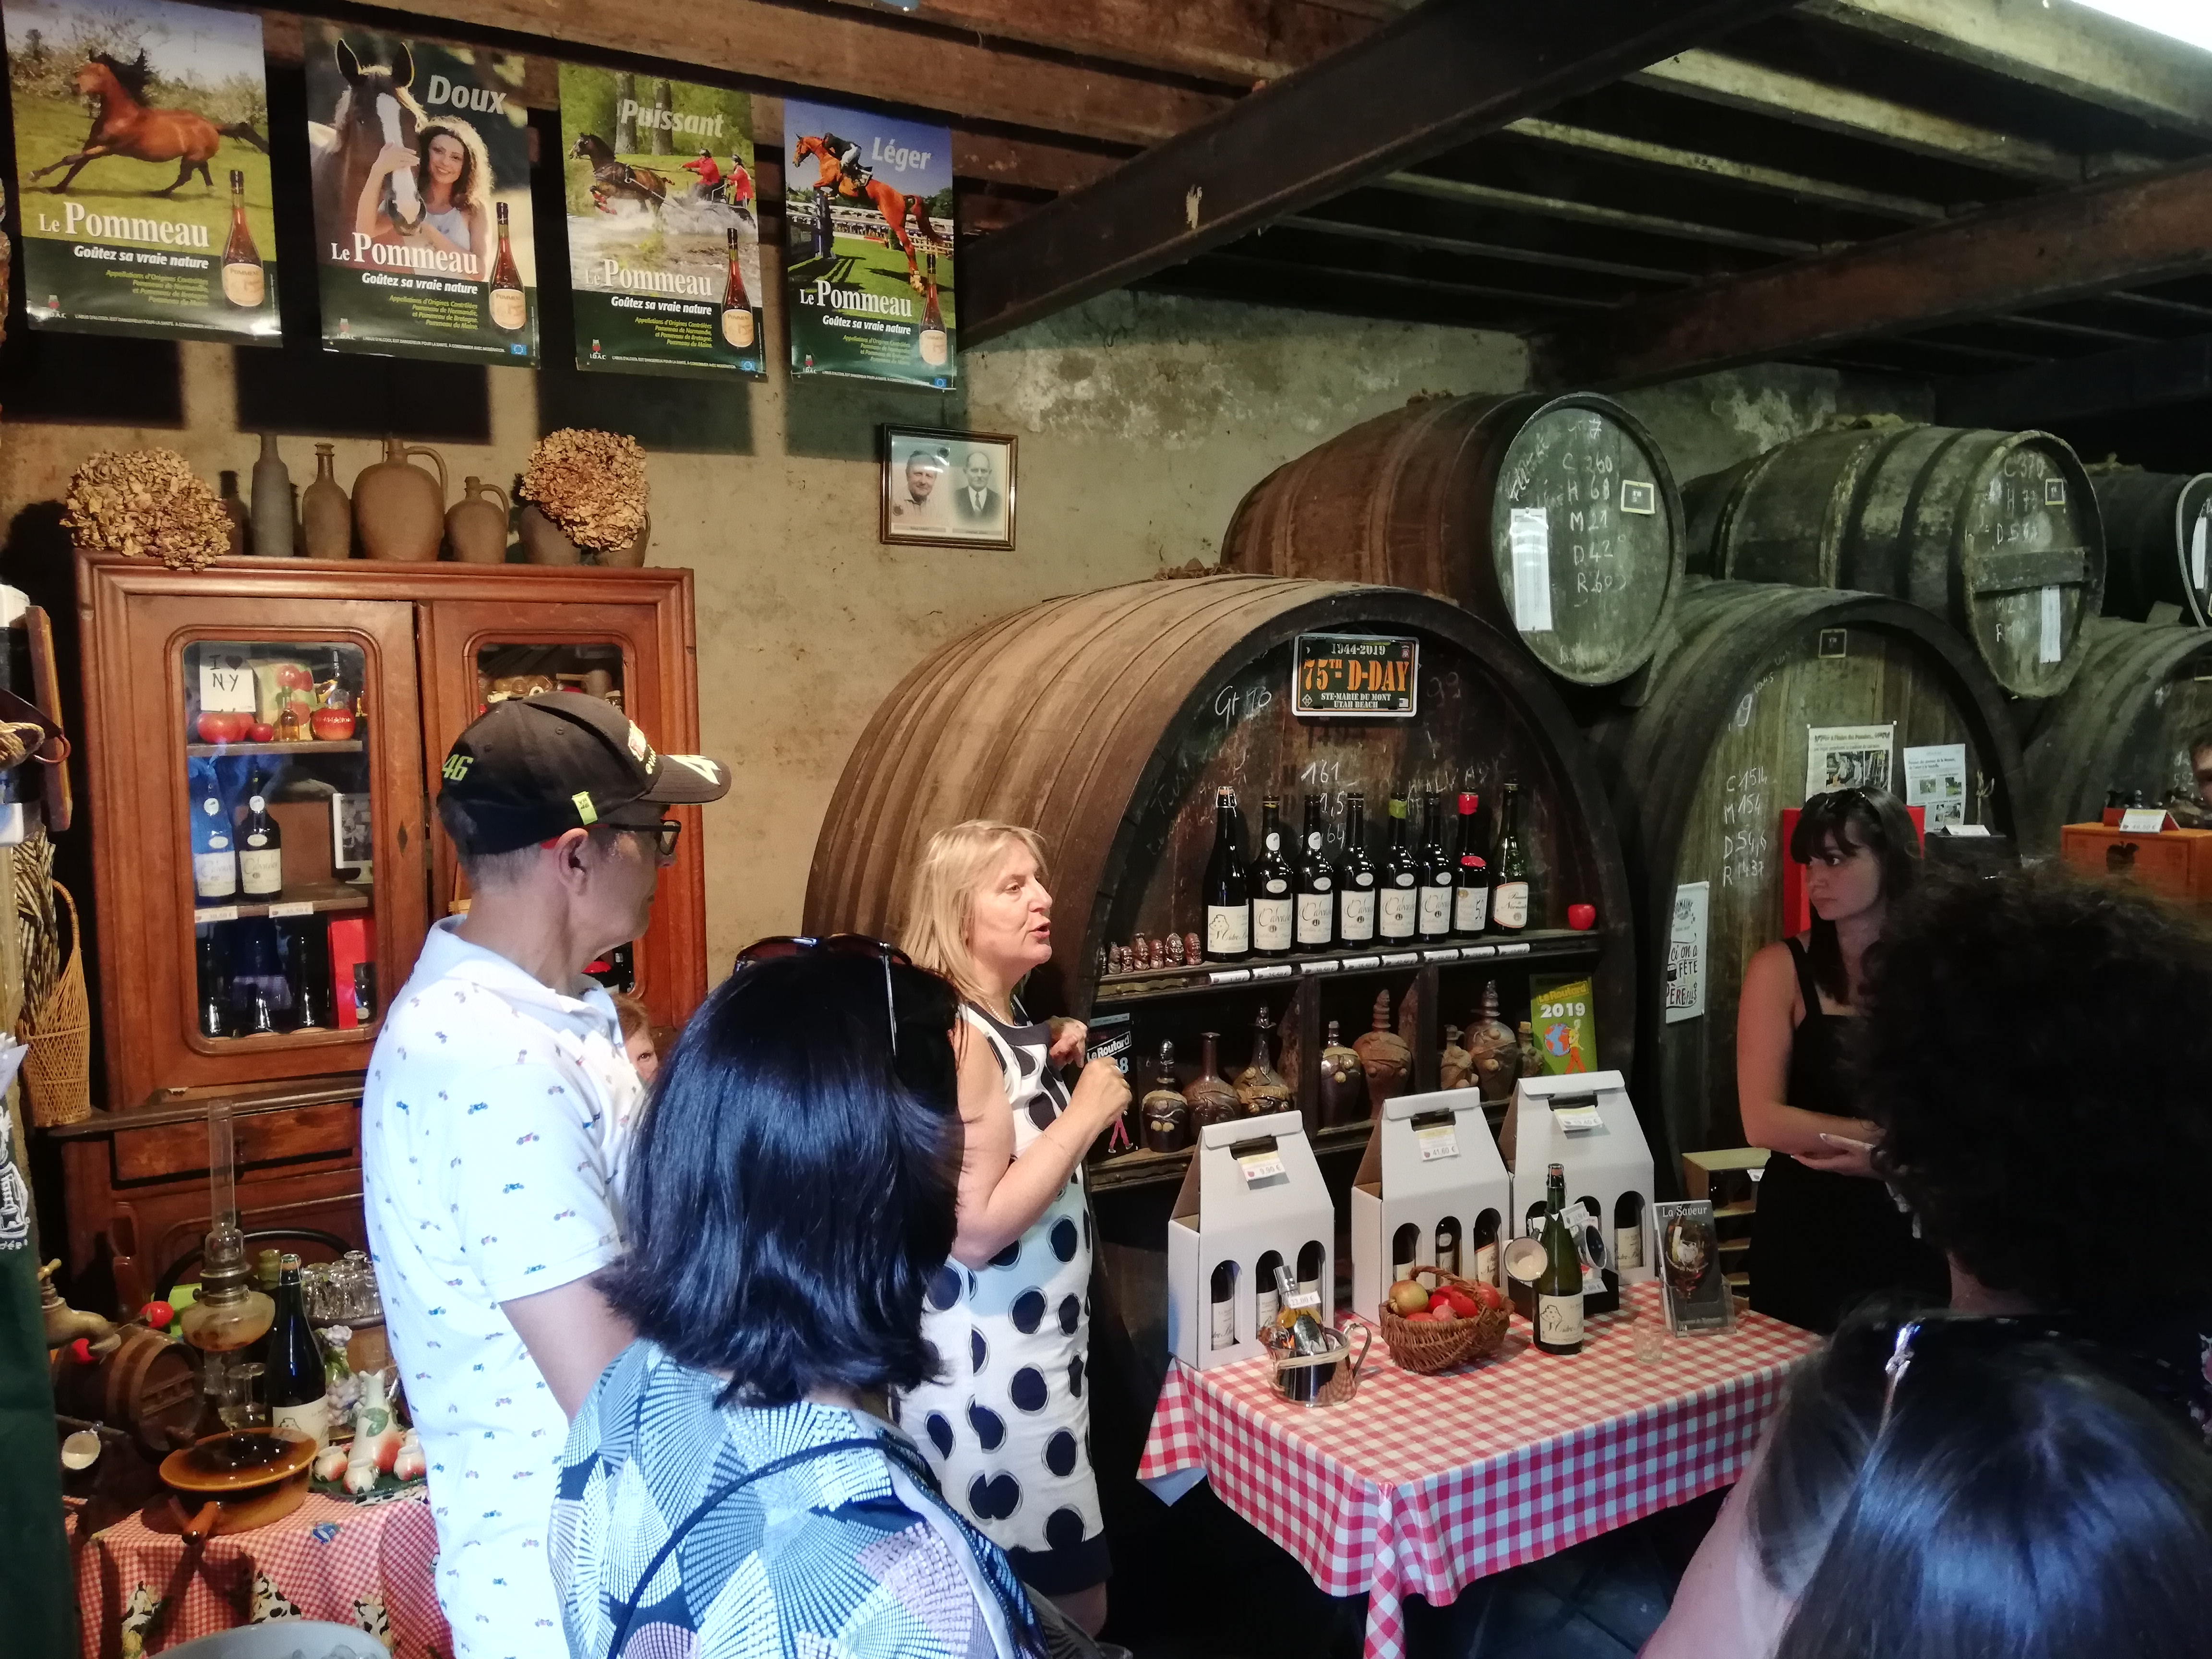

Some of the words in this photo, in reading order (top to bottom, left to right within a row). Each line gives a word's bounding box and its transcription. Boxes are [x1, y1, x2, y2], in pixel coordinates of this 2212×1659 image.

[427, 74, 507, 114] Doux
[621, 99, 725, 138] Puissant
[872, 136, 932, 171] Léger
[39, 214, 60, 233] Le
[63, 201, 210, 248] Pommeau
[74, 245, 117, 262] Goûtez
[119, 251, 133, 262] sa
[136, 252, 168, 265] vraie
[170, 256, 209, 269] nature
[331, 242, 350, 262] Le
[352, 232, 479, 275] Pommeau
[362, 272, 398, 287] Goûtez
[401, 279, 413, 288] sa
[416, 279, 442, 291] vraie
[444, 283, 478, 295] nature
[585, 269, 601, 286] Le
[602, 258, 713, 296] Pommeau
[611, 296, 643, 308] Goûtez
[658, 301, 681, 313] vraie
[683, 305, 712, 315] nature
[800, 289, 814, 305] Le
[816, 279, 912, 317] Pommeau
[823, 314, 851, 327] Goûtez
[853, 320, 862, 329] sa
[864, 321, 884, 332] vraie
[886, 325, 911, 335] nature
[1570, 511, 1584, 531] M
[1573, 545, 1585, 566] D
[1577, 573, 1588, 593] R
[1331, 643, 1386, 655] 1944-2019
[1347, 660, 1409, 691] D-DAY
[1321, 693, 1358, 701] STE-MARIE
[442, 754, 474, 781] 46
[1727, 776, 1736, 792] C
[1724, 804, 1734, 824] M
[1738, 794, 1760, 815] 154
[1723, 836, 1733, 860] D
[1723, 866, 1732, 887] R
[1539, 994, 1550, 1003] Le
[1550, 984, 1587, 1000] Routard
[1540, 1002, 1586, 1018] 2019
[1087, 1052, 1097, 1062] Le
[1097, 1034, 1130, 1058] Routard
[1662, 1207, 1673, 1217] La
[1676, 1206, 1707, 1216] Saveur
[1290, 1296, 1309, 1306] 22.00
